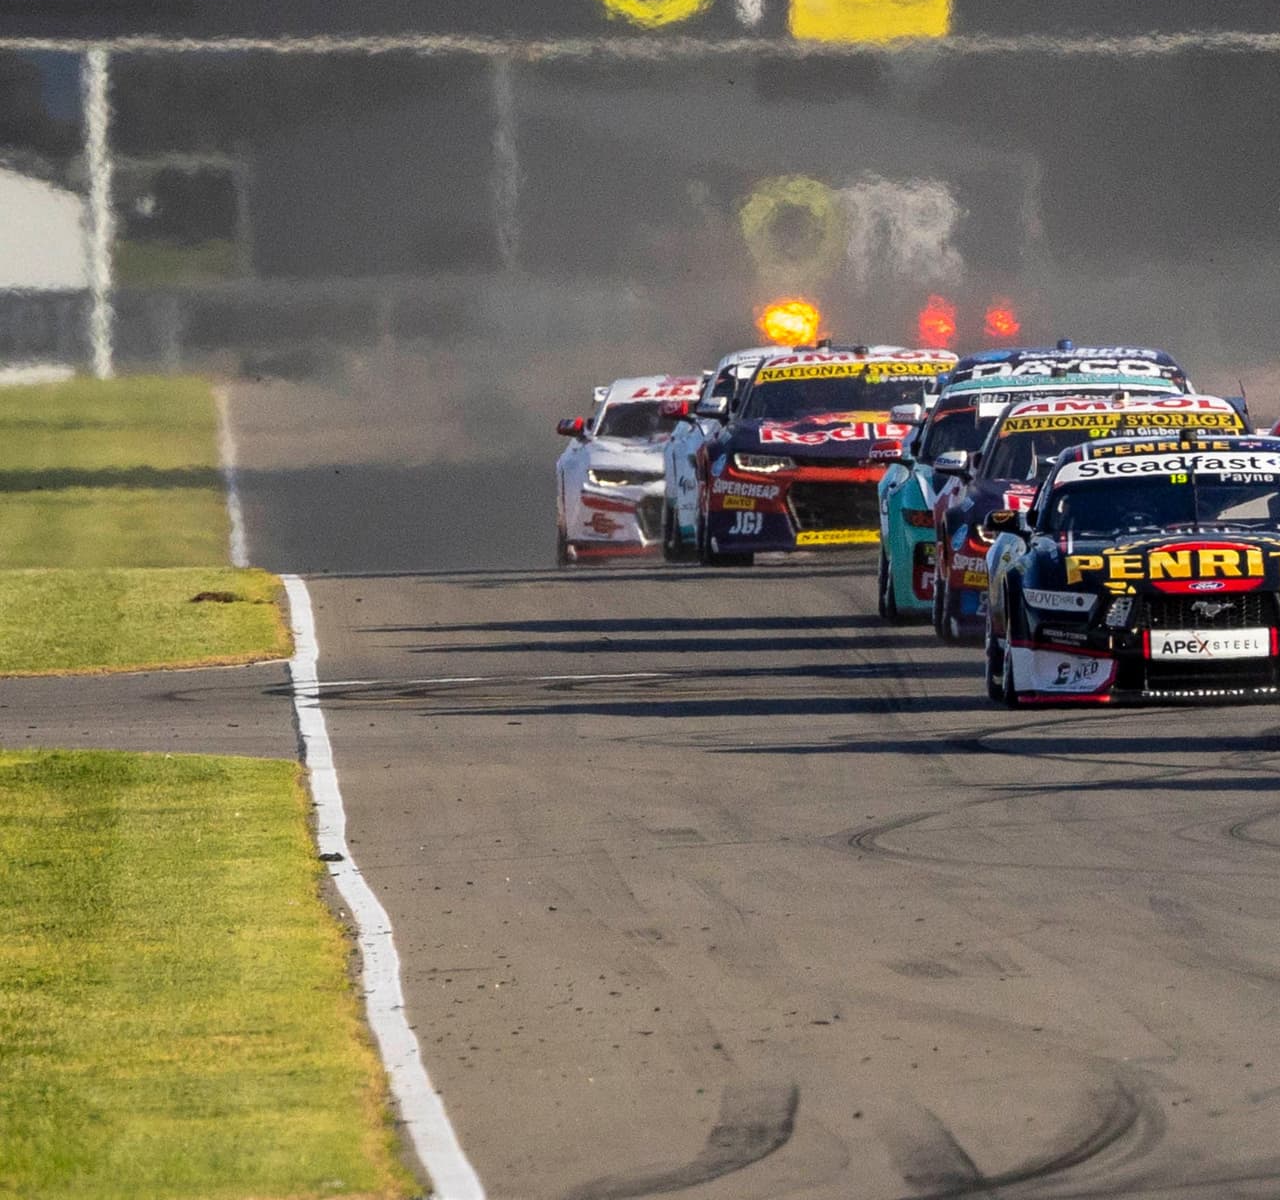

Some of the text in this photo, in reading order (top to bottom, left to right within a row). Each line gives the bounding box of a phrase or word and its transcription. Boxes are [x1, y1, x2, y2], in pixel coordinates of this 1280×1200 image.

[1005, 413, 1233, 433] NATIONAL STORAGE
[1093, 440, 1231, 458] PENRITE
[1078, 454, 1263, 479] Steadfast
[1168, 470, 1274, 485] 19 Payne
[1161, 636, 1260, 657] APEX STEEL
